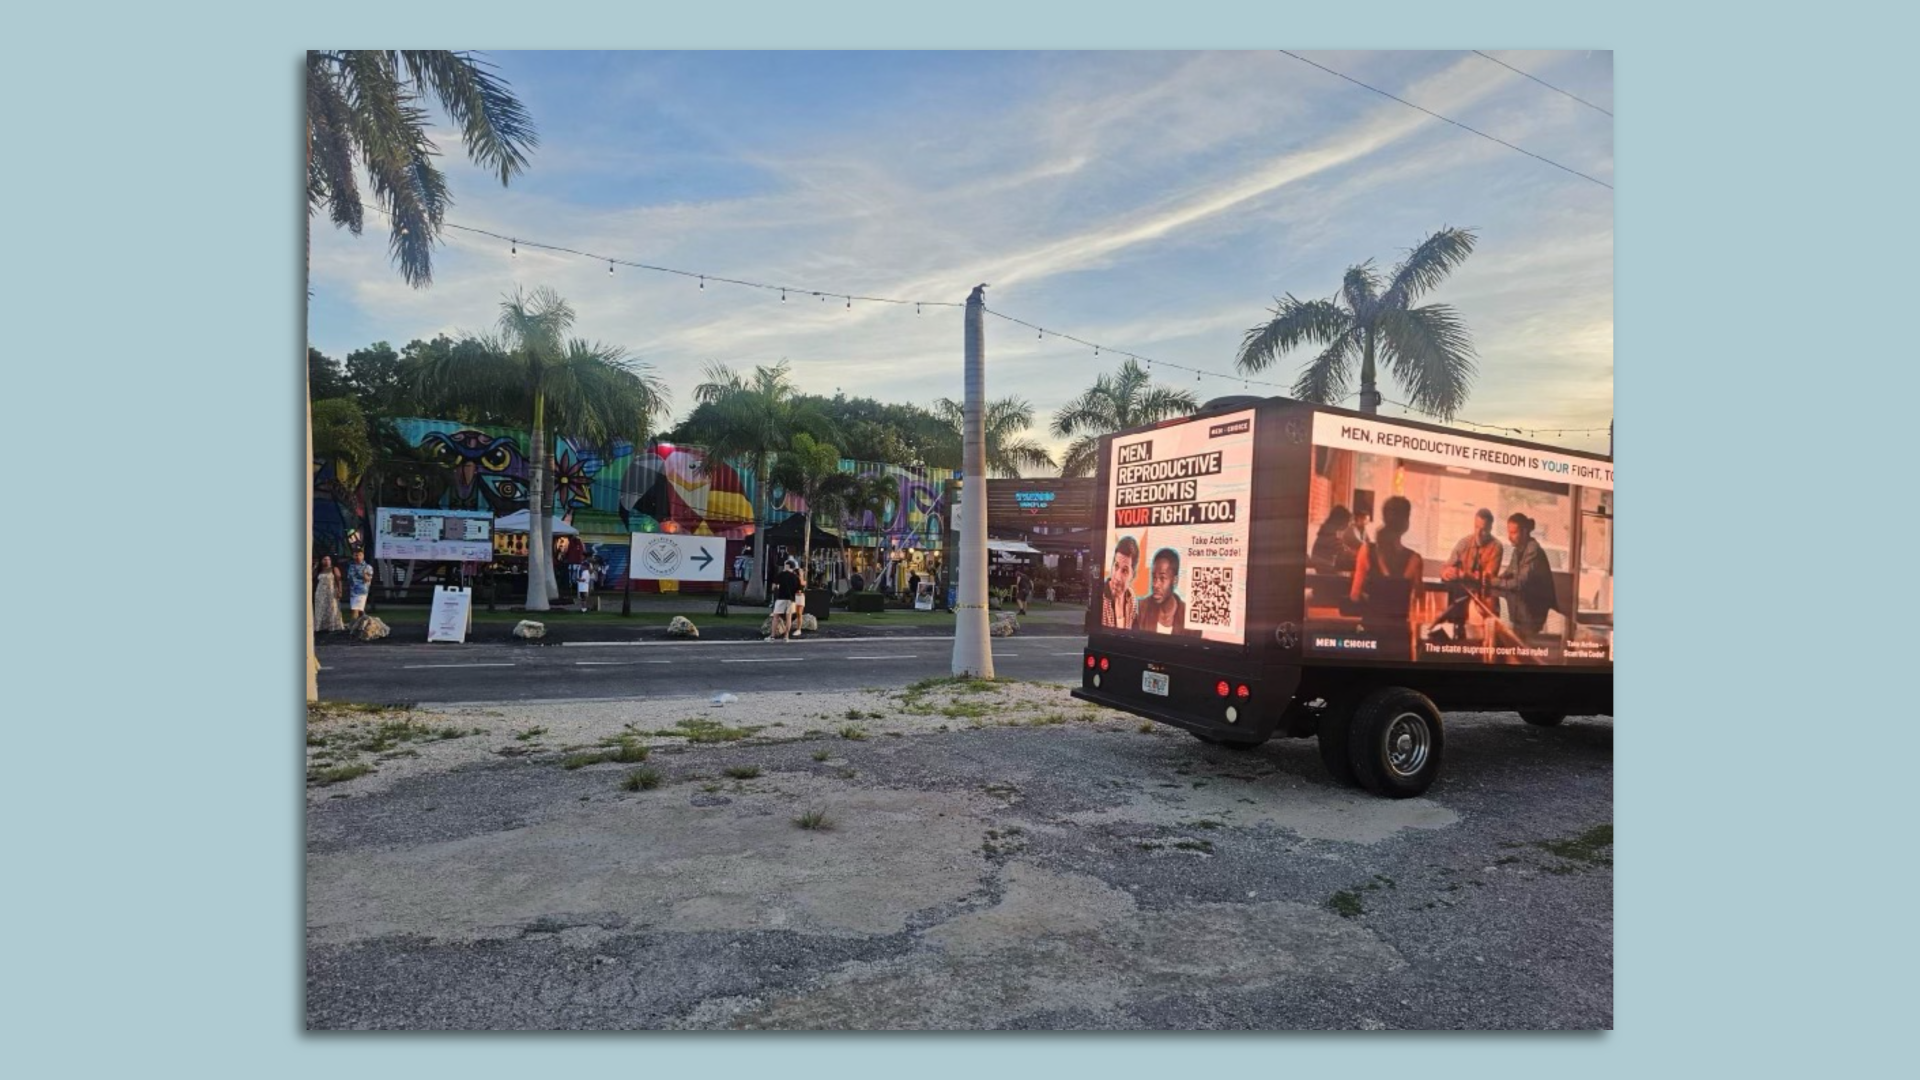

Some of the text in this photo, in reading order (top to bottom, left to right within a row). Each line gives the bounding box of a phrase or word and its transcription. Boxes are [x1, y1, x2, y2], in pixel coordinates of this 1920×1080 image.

[1120, 442, 1149, 463] MEN,
[1341, 425, 1374, 445] MEN,
[1377, 431, 1470, 459] REPRODUCTIVE
[1472, 448, 1526, 468] FREEDOM
[1528, 457, 1539, 469] IS
[1541, 459, 1569, 474] YOUR
[1571, 464, 1603, 481] FIGHT,
[1118, 453, 1220, 484] REPRODUCTIVE
[1117, 481, 1195, 505] FREEDOM IS
[1116, 501, 1234, 526] YOUR FIGHT, TOO.
[1192, 535, 1208, 546] Take
[1209, 534, 1233, 545] Action
[1188, 547, 1241, 557] Scan the Code!
[1315, 637, 1336, 647] MEN
[1343, 639, 1377, 650] CHOICE
[1425, 642, 1549, 657] The state supreme court has ruled
